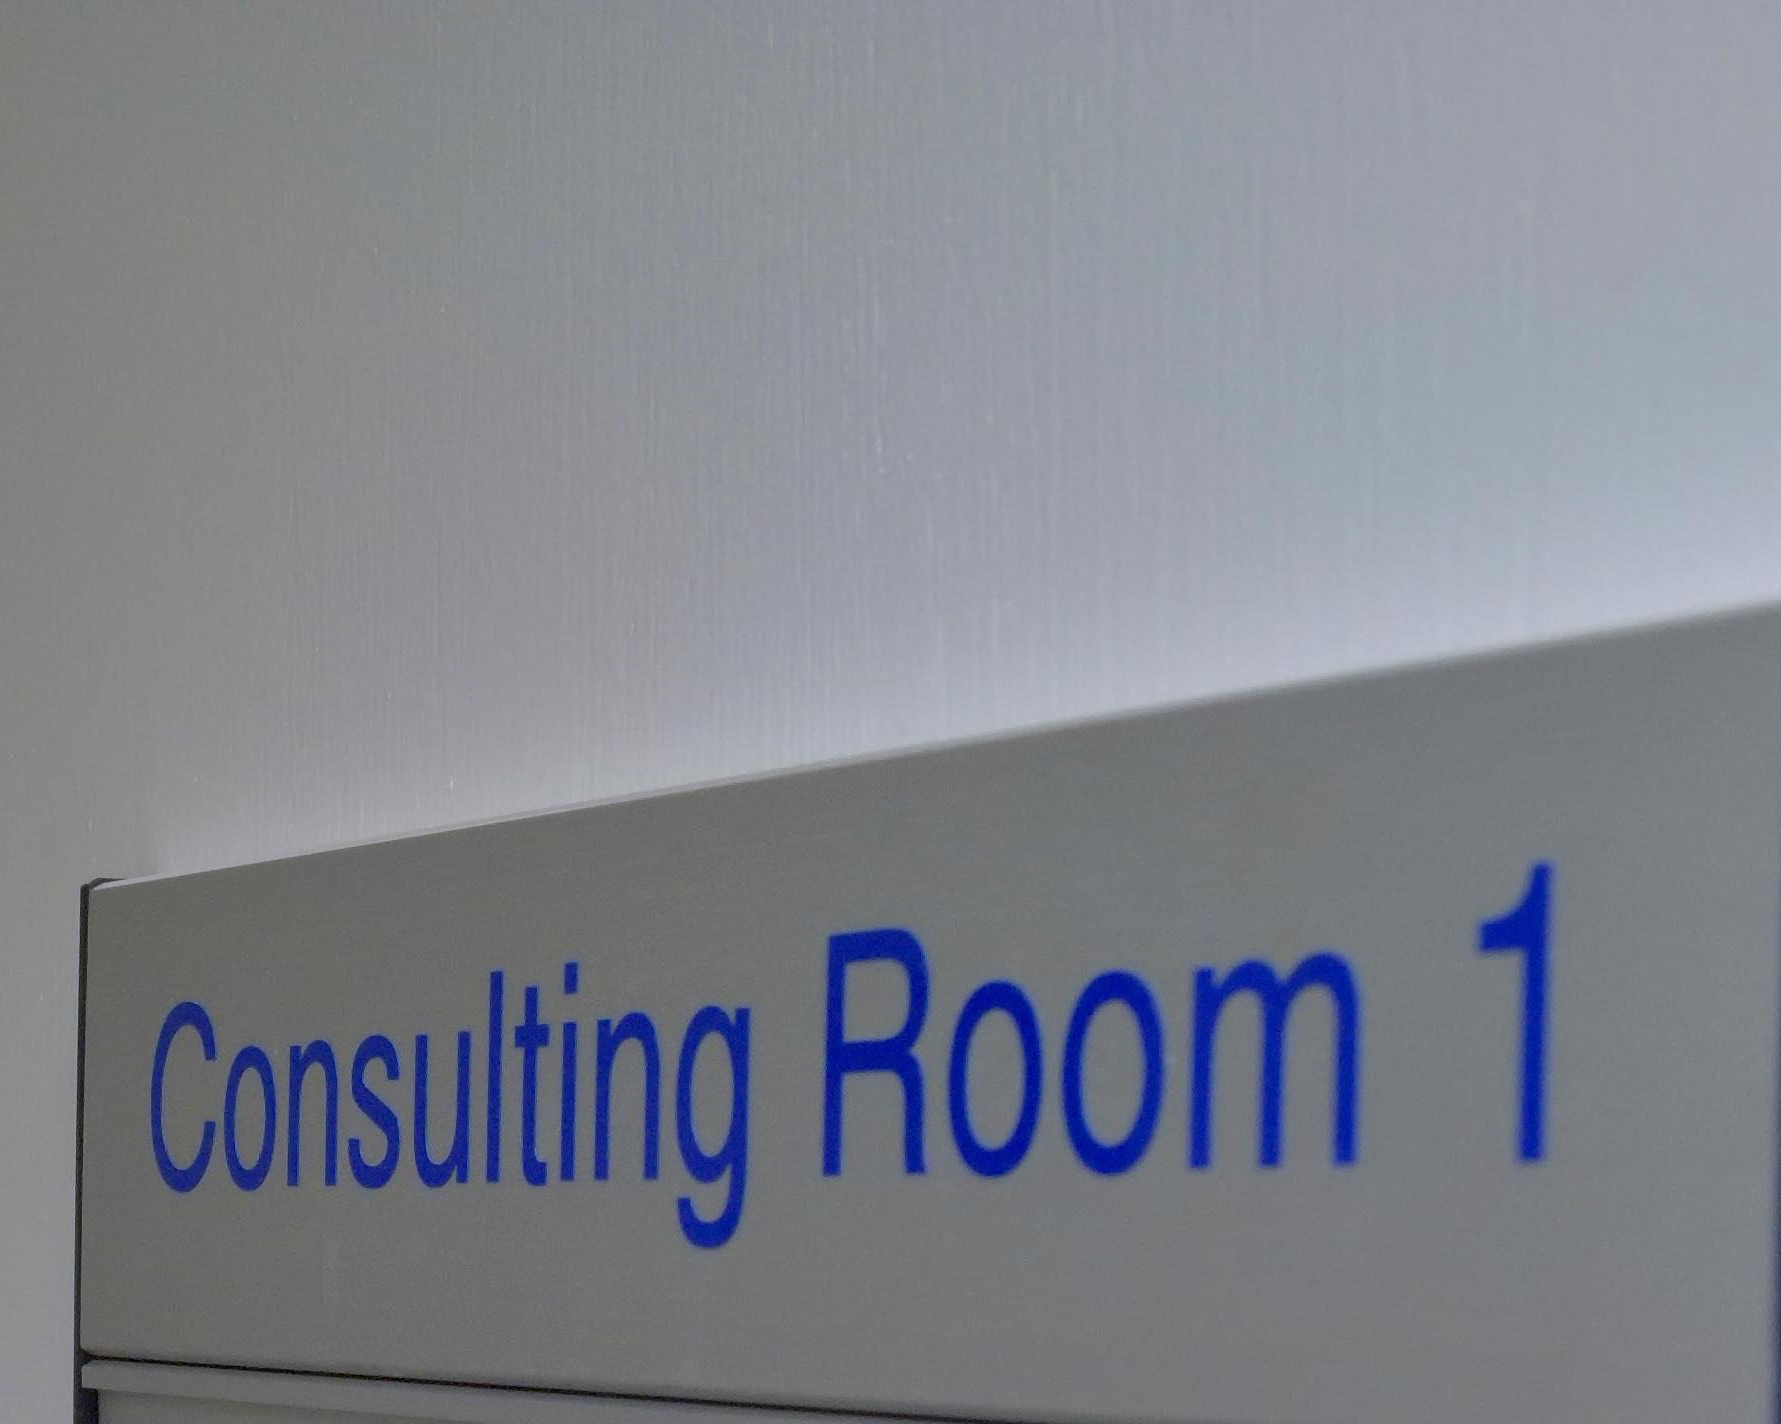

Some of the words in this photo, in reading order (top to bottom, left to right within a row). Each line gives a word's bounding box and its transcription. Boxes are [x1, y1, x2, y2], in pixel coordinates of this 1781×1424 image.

[150, 958, 752, 1249] Consulting
[820, 926, 1362, 1180] Room
[1475, 858, 1557, 1164] 1
